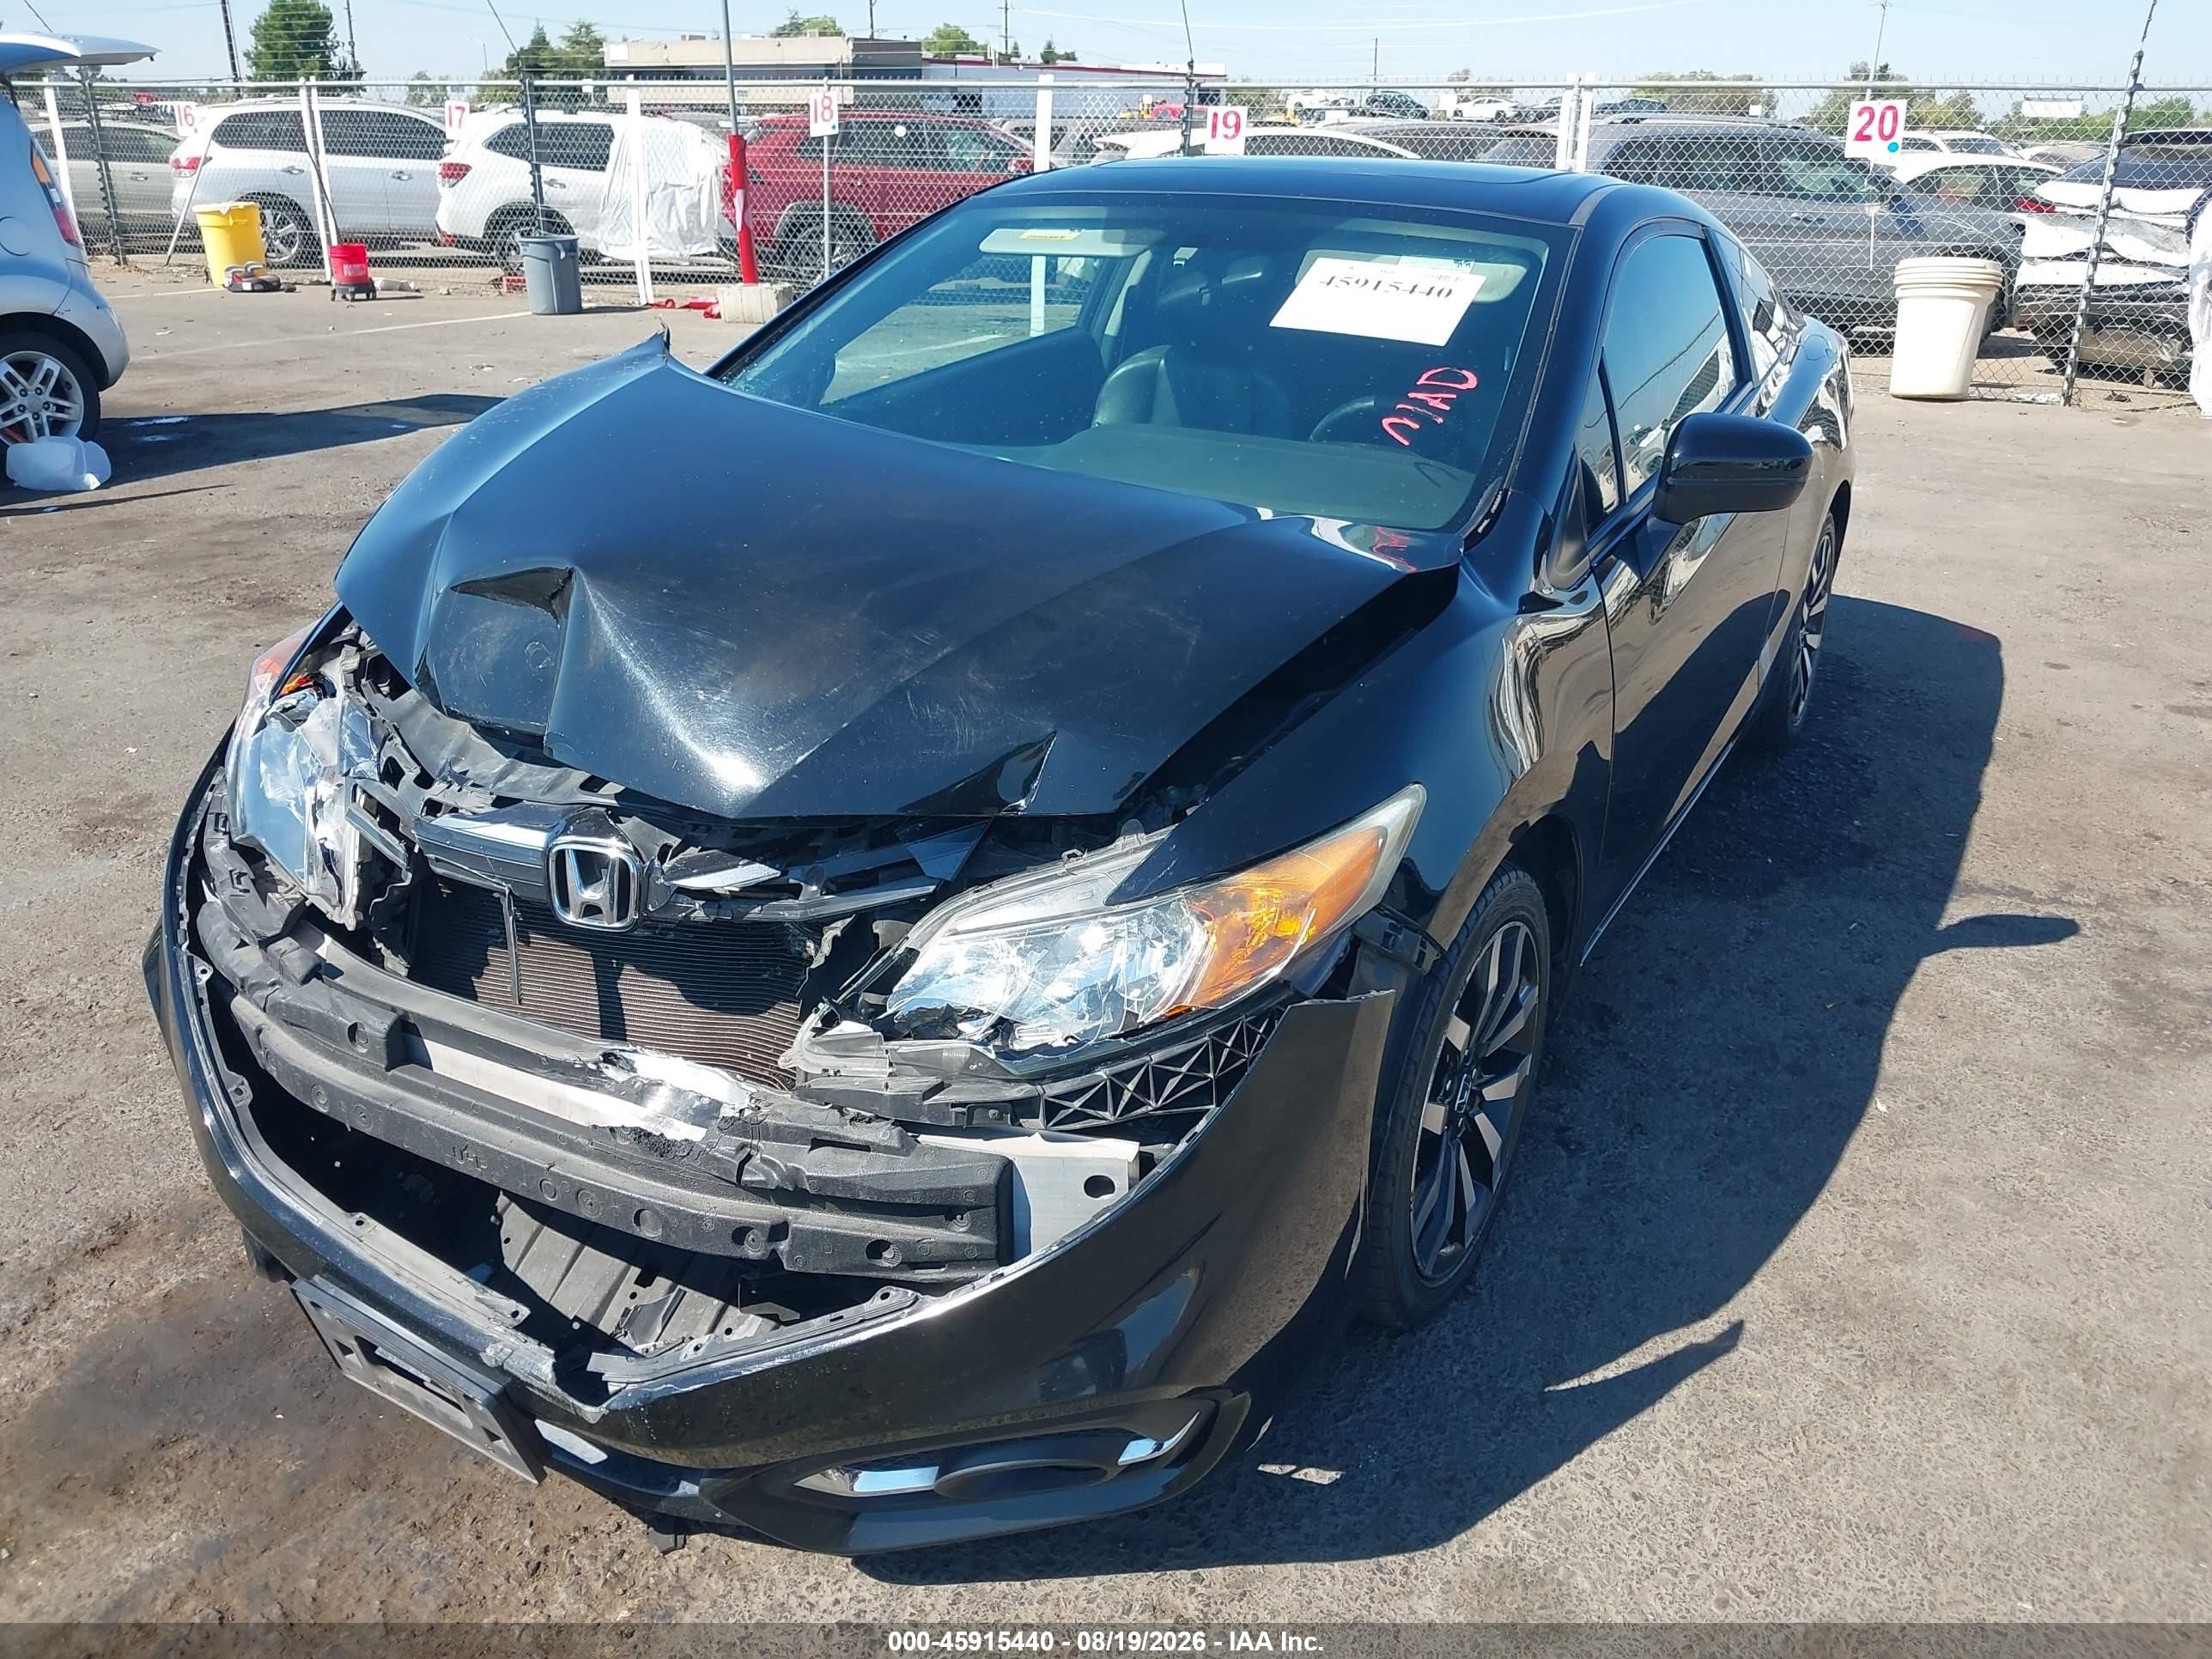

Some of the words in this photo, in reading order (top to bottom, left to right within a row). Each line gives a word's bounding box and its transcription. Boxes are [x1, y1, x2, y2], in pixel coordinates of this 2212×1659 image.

[177, 104, 195, 127] 16
[447, 105, 465, 129] 17
[814, 95, 834, 125] 18
[1211, 110, 1241, 140] 19
[1854, 105, 1899, 142] 20
